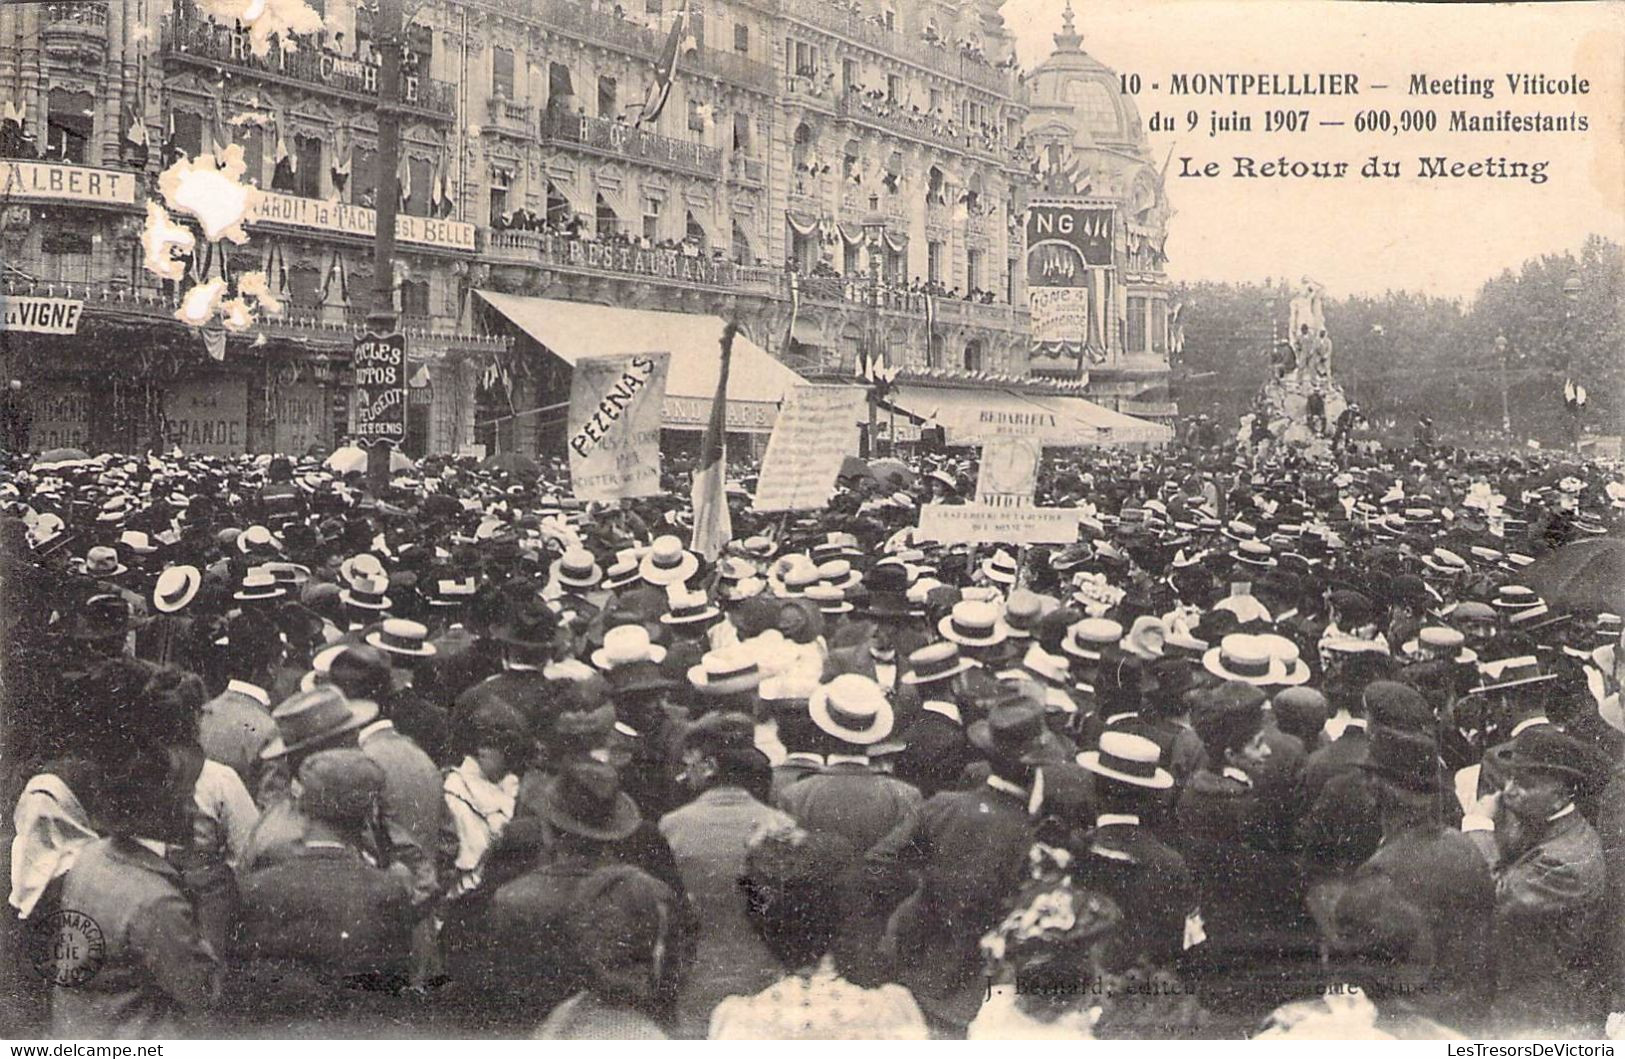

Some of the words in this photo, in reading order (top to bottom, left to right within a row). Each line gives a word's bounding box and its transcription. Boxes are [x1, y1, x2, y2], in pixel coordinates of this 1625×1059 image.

[3, 163, 120, 197] ALBERT
[254, 194, 306, 223] ARDI!
[333, 203, 378, 234] TACH
[424, 219, 473, 245] BELLE
[1037, 212, 1074, 234] NG
[569, 240, 721, 282] RESTAURANT
[18, 301, 79, 329] VIGNE
[570, 354, 655, 459] PEZENAS
[661, 399, 700, 421] AND
[167, 419, 240, 446] GRANDE
